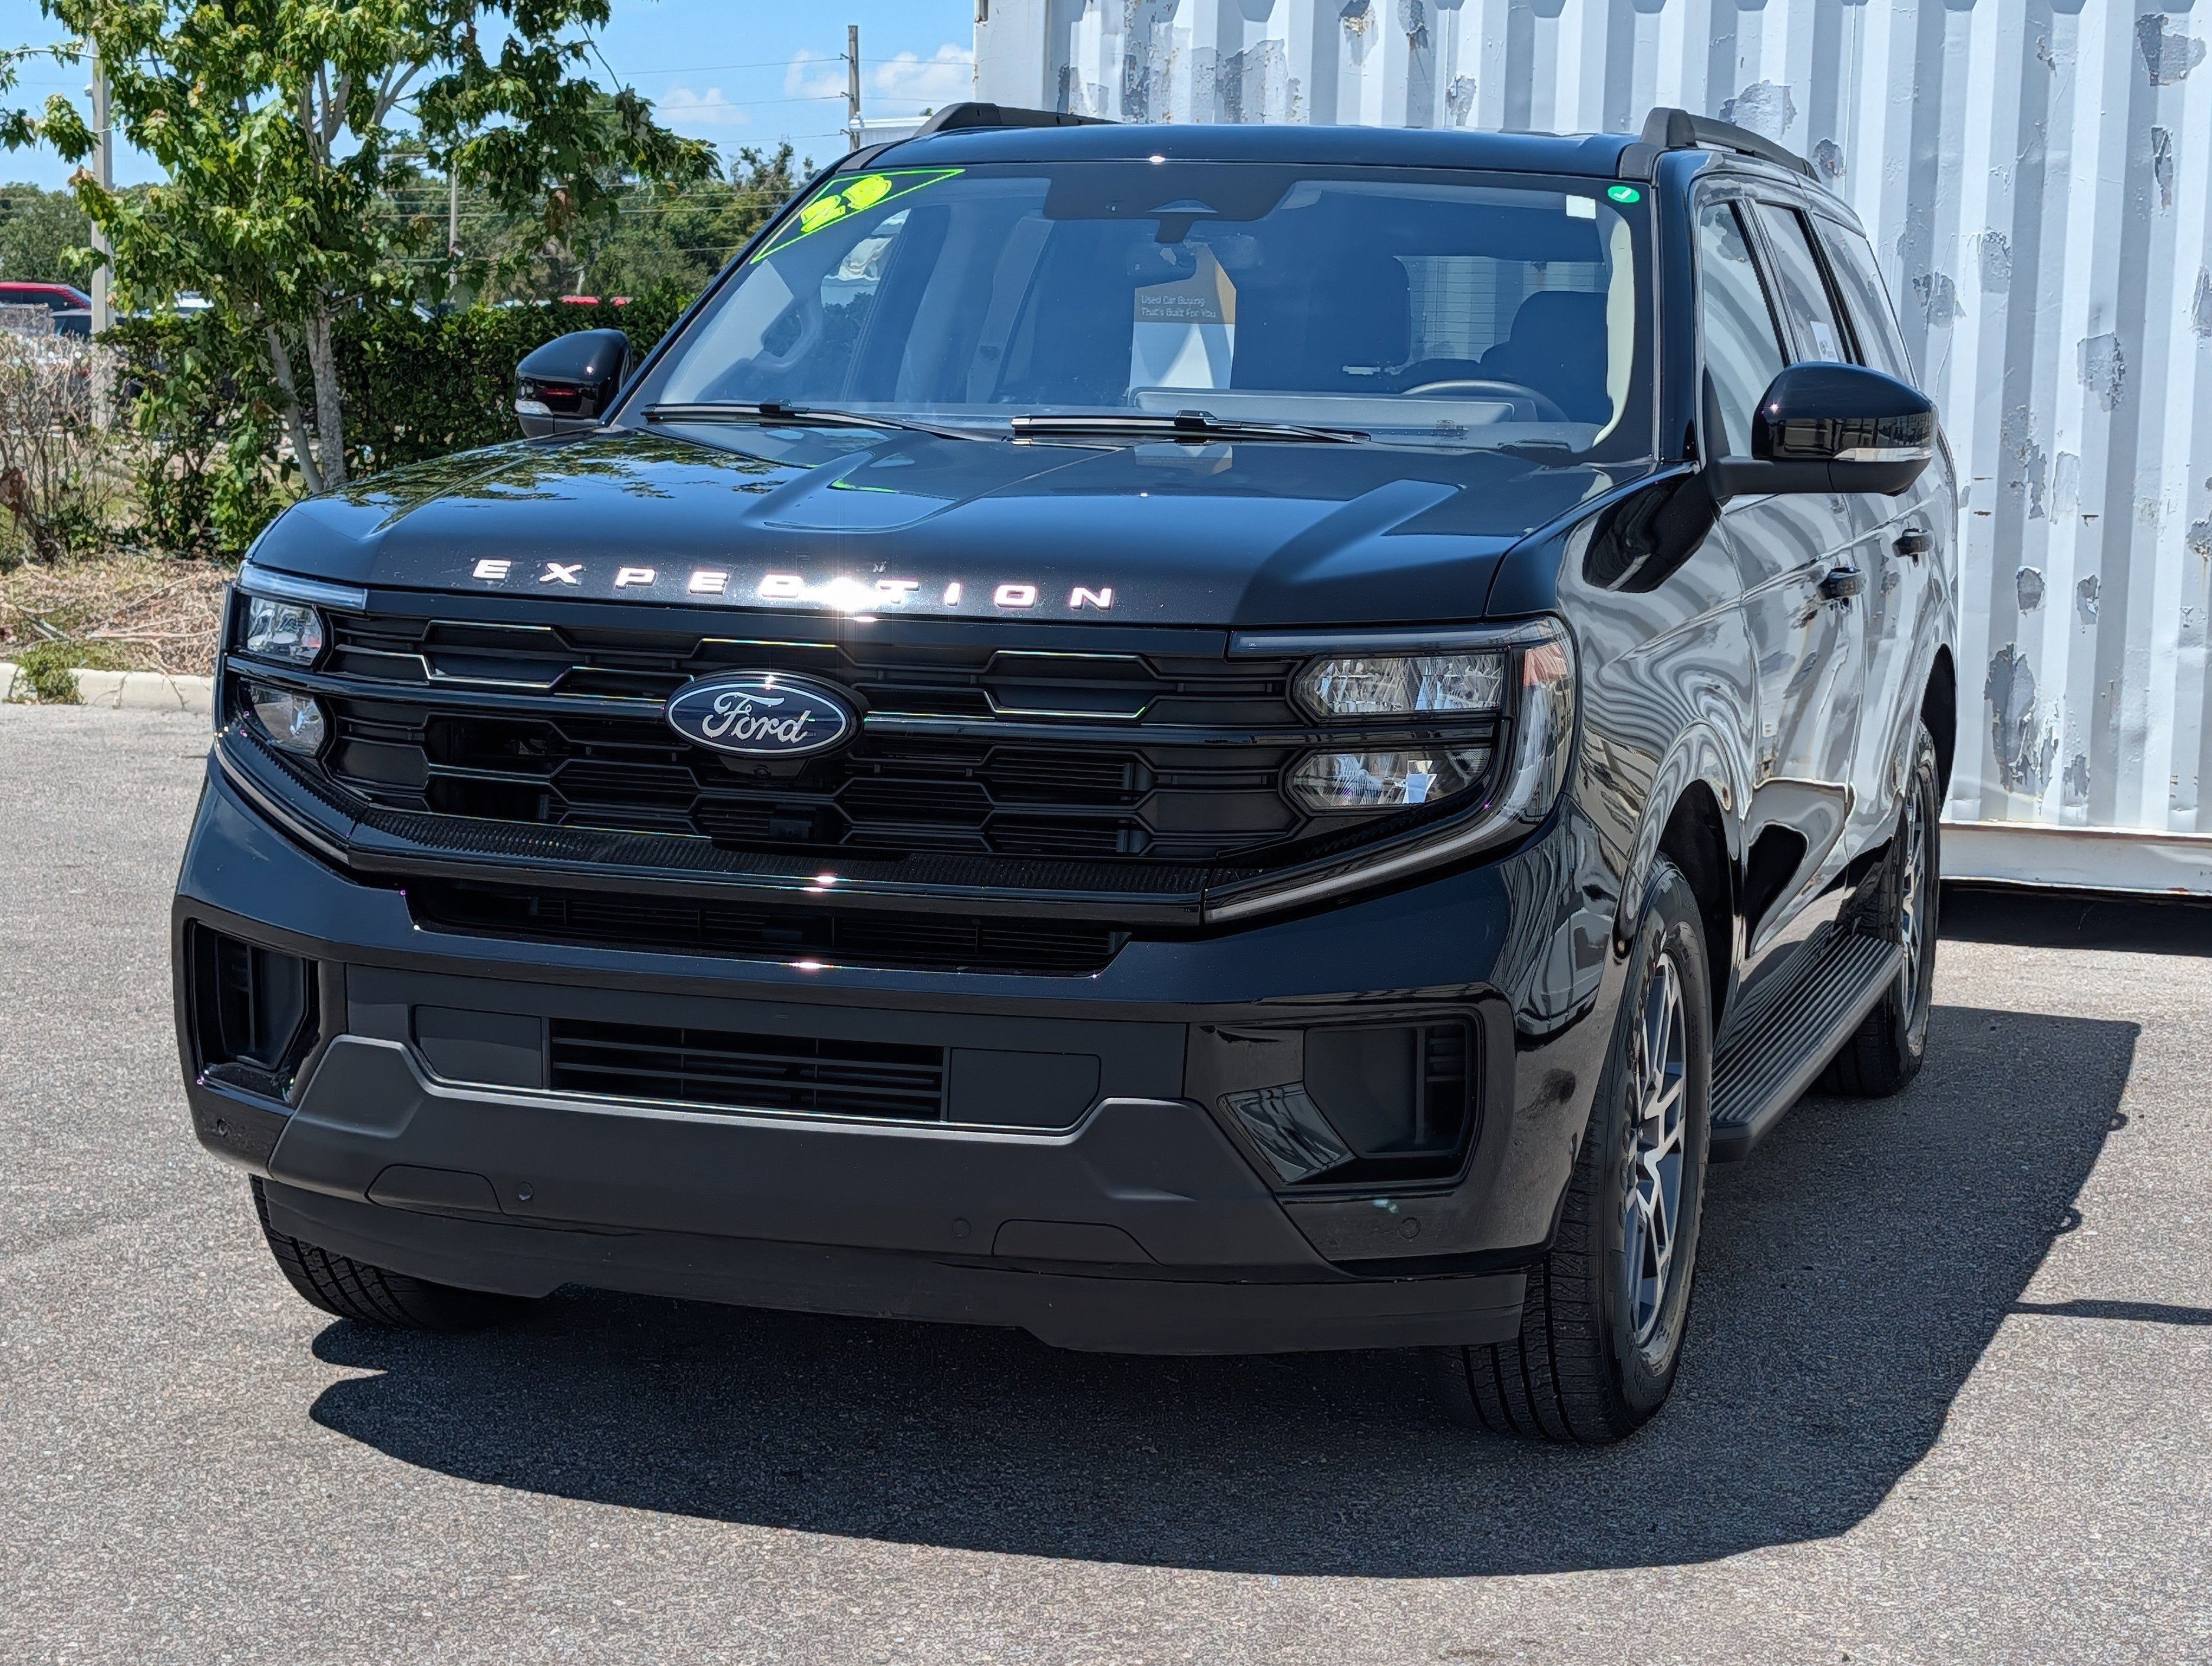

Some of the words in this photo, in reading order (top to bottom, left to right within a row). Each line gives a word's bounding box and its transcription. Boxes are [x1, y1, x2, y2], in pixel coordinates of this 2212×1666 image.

[1141, 295, 1161, 304] Used
[1163, 296, 1176, 304] Car
[1178, 296, 1205, 307] Buying
[1186, 308, 1199, 317] For
[1201, 308, 1216, 318] You
[472, 559, 1114, 611] EXPEDTION
[702, 691, 812, 743] Ford
